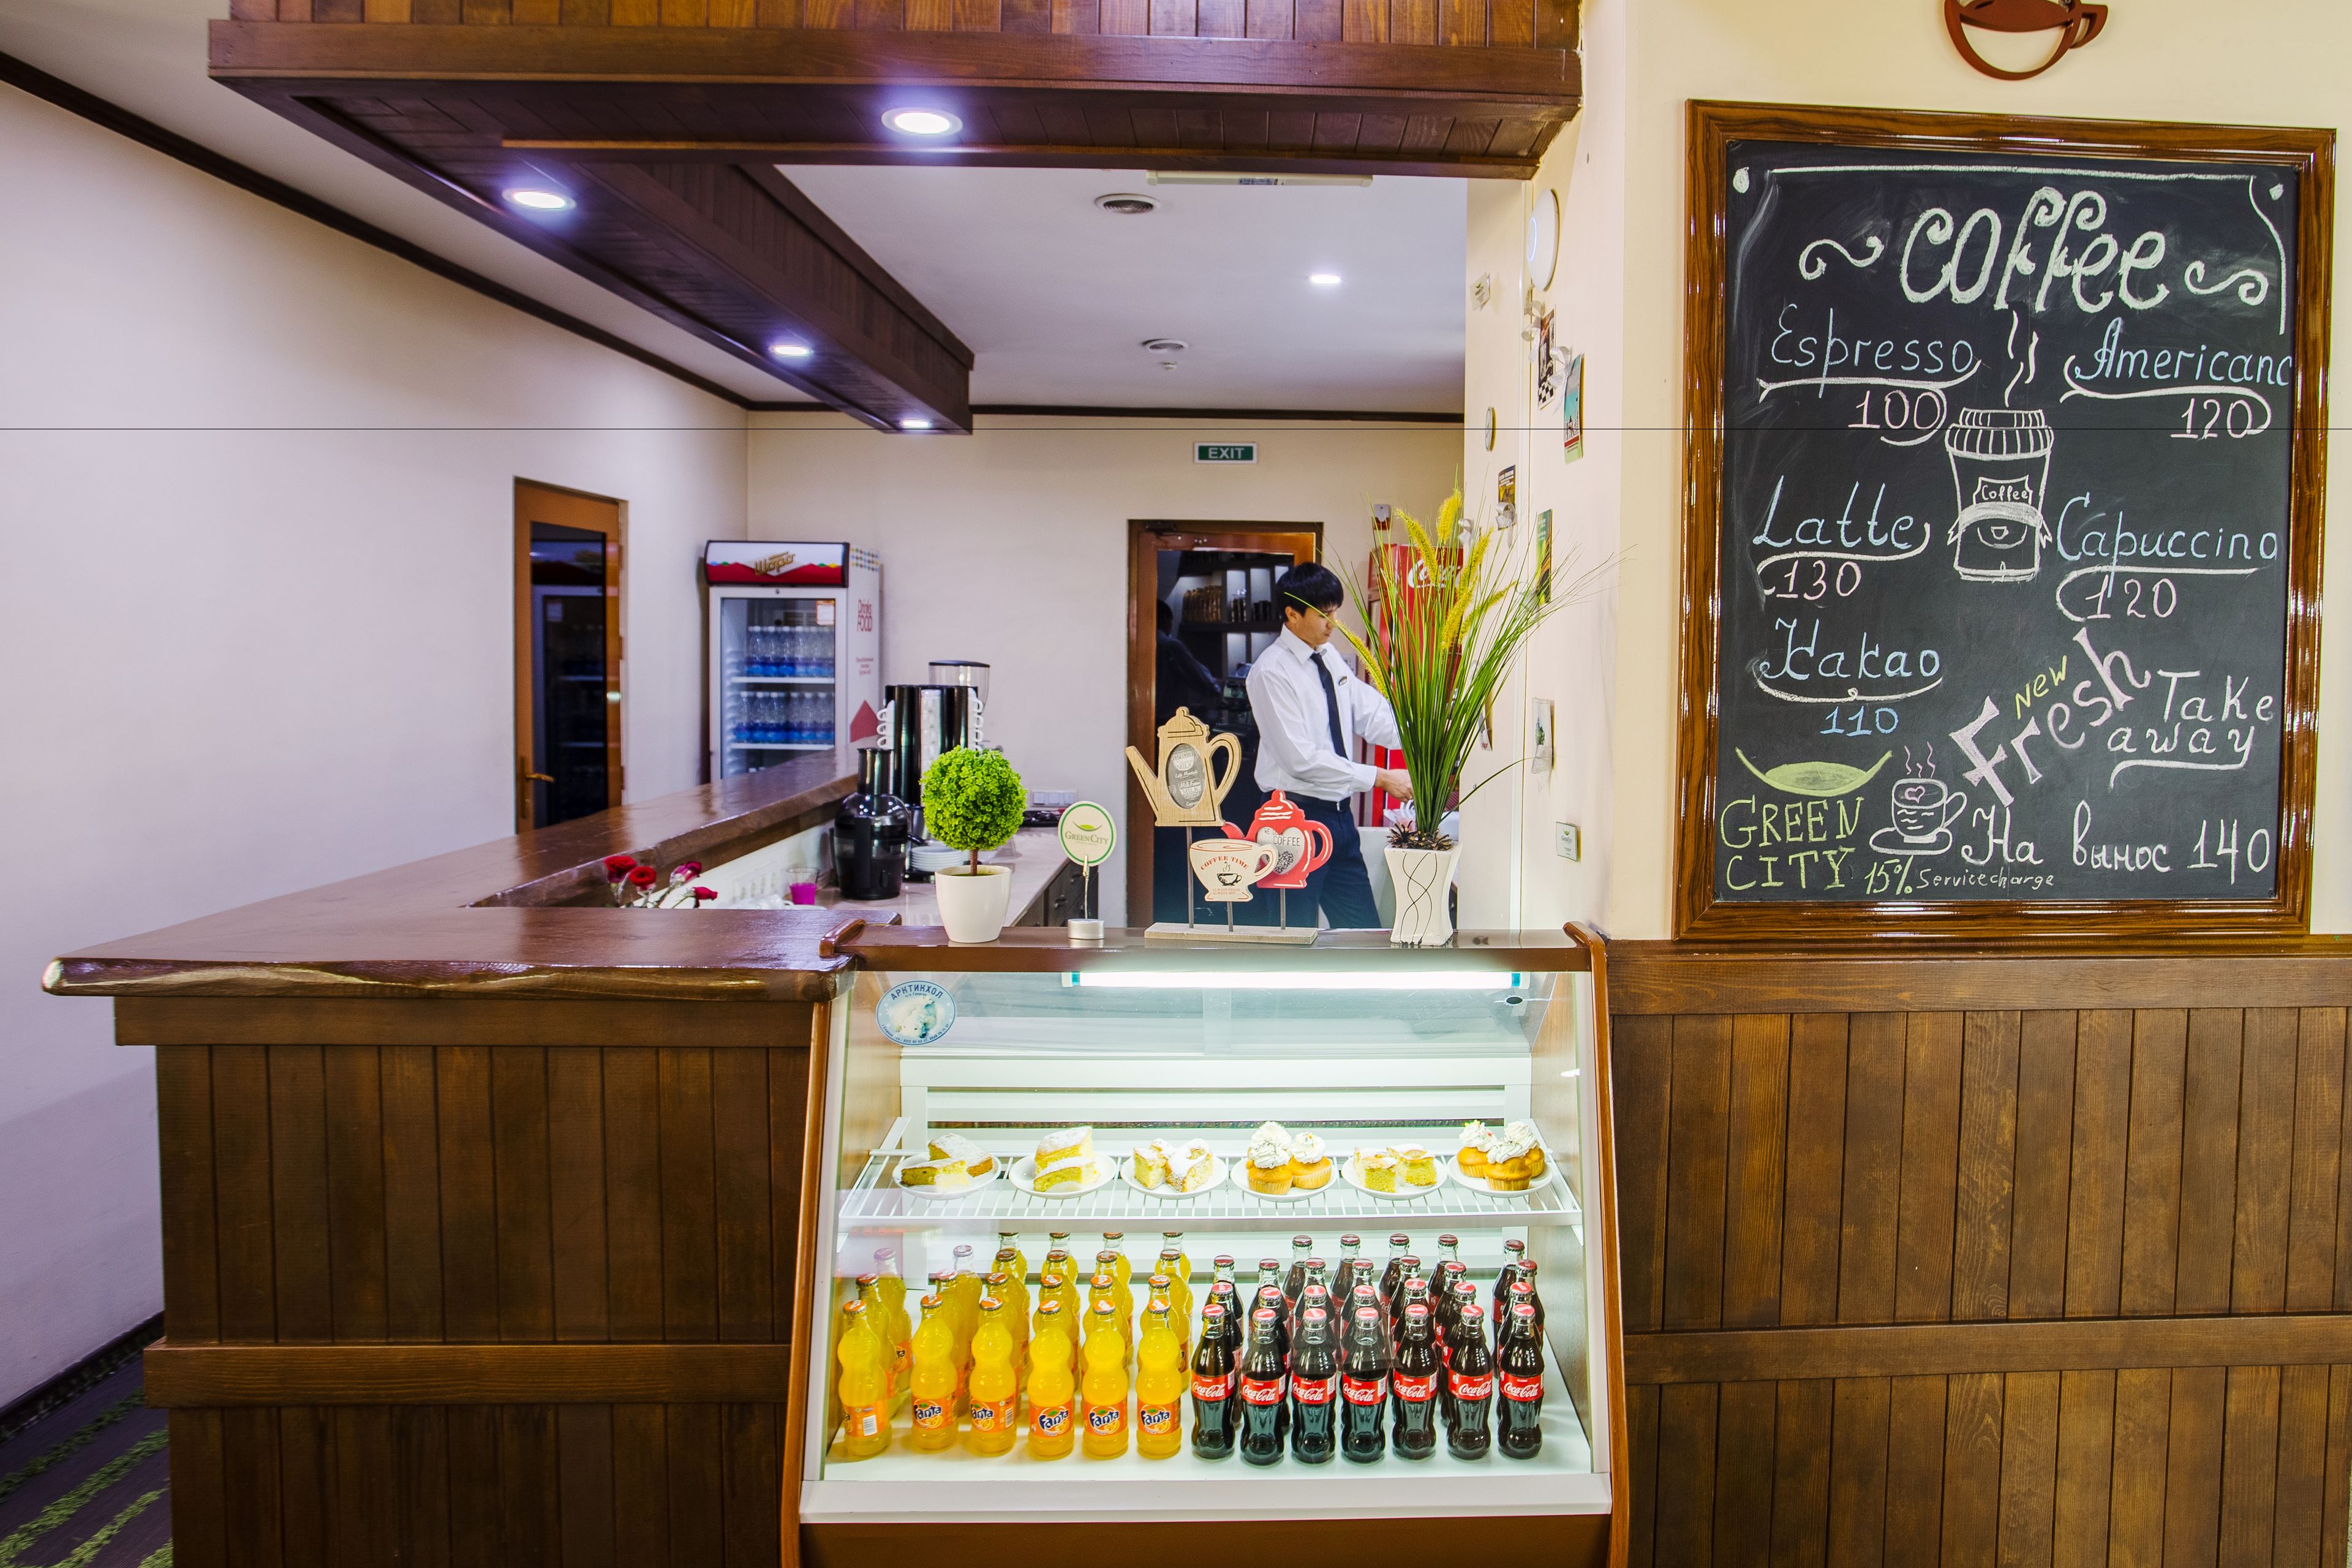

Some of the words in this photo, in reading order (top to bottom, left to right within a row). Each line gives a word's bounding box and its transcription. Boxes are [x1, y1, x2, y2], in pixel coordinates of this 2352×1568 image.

[1771, 303, 1973, 399] Espresso
[1848, 390, 1941, 429] 100
[2170, 397, 2251, 440] 120
[1208, 447, 1245, 459] EXIT
[1753, 475, 1914, 549] Latte
[1981, 484, 2029, 502] Coffee
[2057, 492, 2278, 598] Capuccino
[1776, 560, 1862, 600] 130
[2085, 575, 2177, 619] 120
[2157, 669, 2274, 723] Take
[1820, 706, 1899, 737] 110
[1949, 627, 2152, 808] Fresh
[2106, 722, 2255, 773] away
[1273, 835, 1301, 846] COFFEE
[1720, 794, 1865, 849] GREEN
[1200, 855, 1228, 870] COFFEE
[1231, 856, 1250, 870] TIME
[1726, 847, 1856, 891] CITY
[2187, 819, 2270, 886] 140
[1864, 855, 1915, 895] 15%
[1193, 1381, 1226, 1397] Coca-Cola
[1242, 1384, 1278, 1401] Coca-Cola
[1394, 1379, 1428, 1398] Coca-Cola
[1504, 1382, 1540, 1398] Coca-Cola
[1038, 1409, 1069, 1430] Fanta
[1089, 1411, 1119, 1428] Fanta
[1140, 1410, 1170, 1426] Fanta
